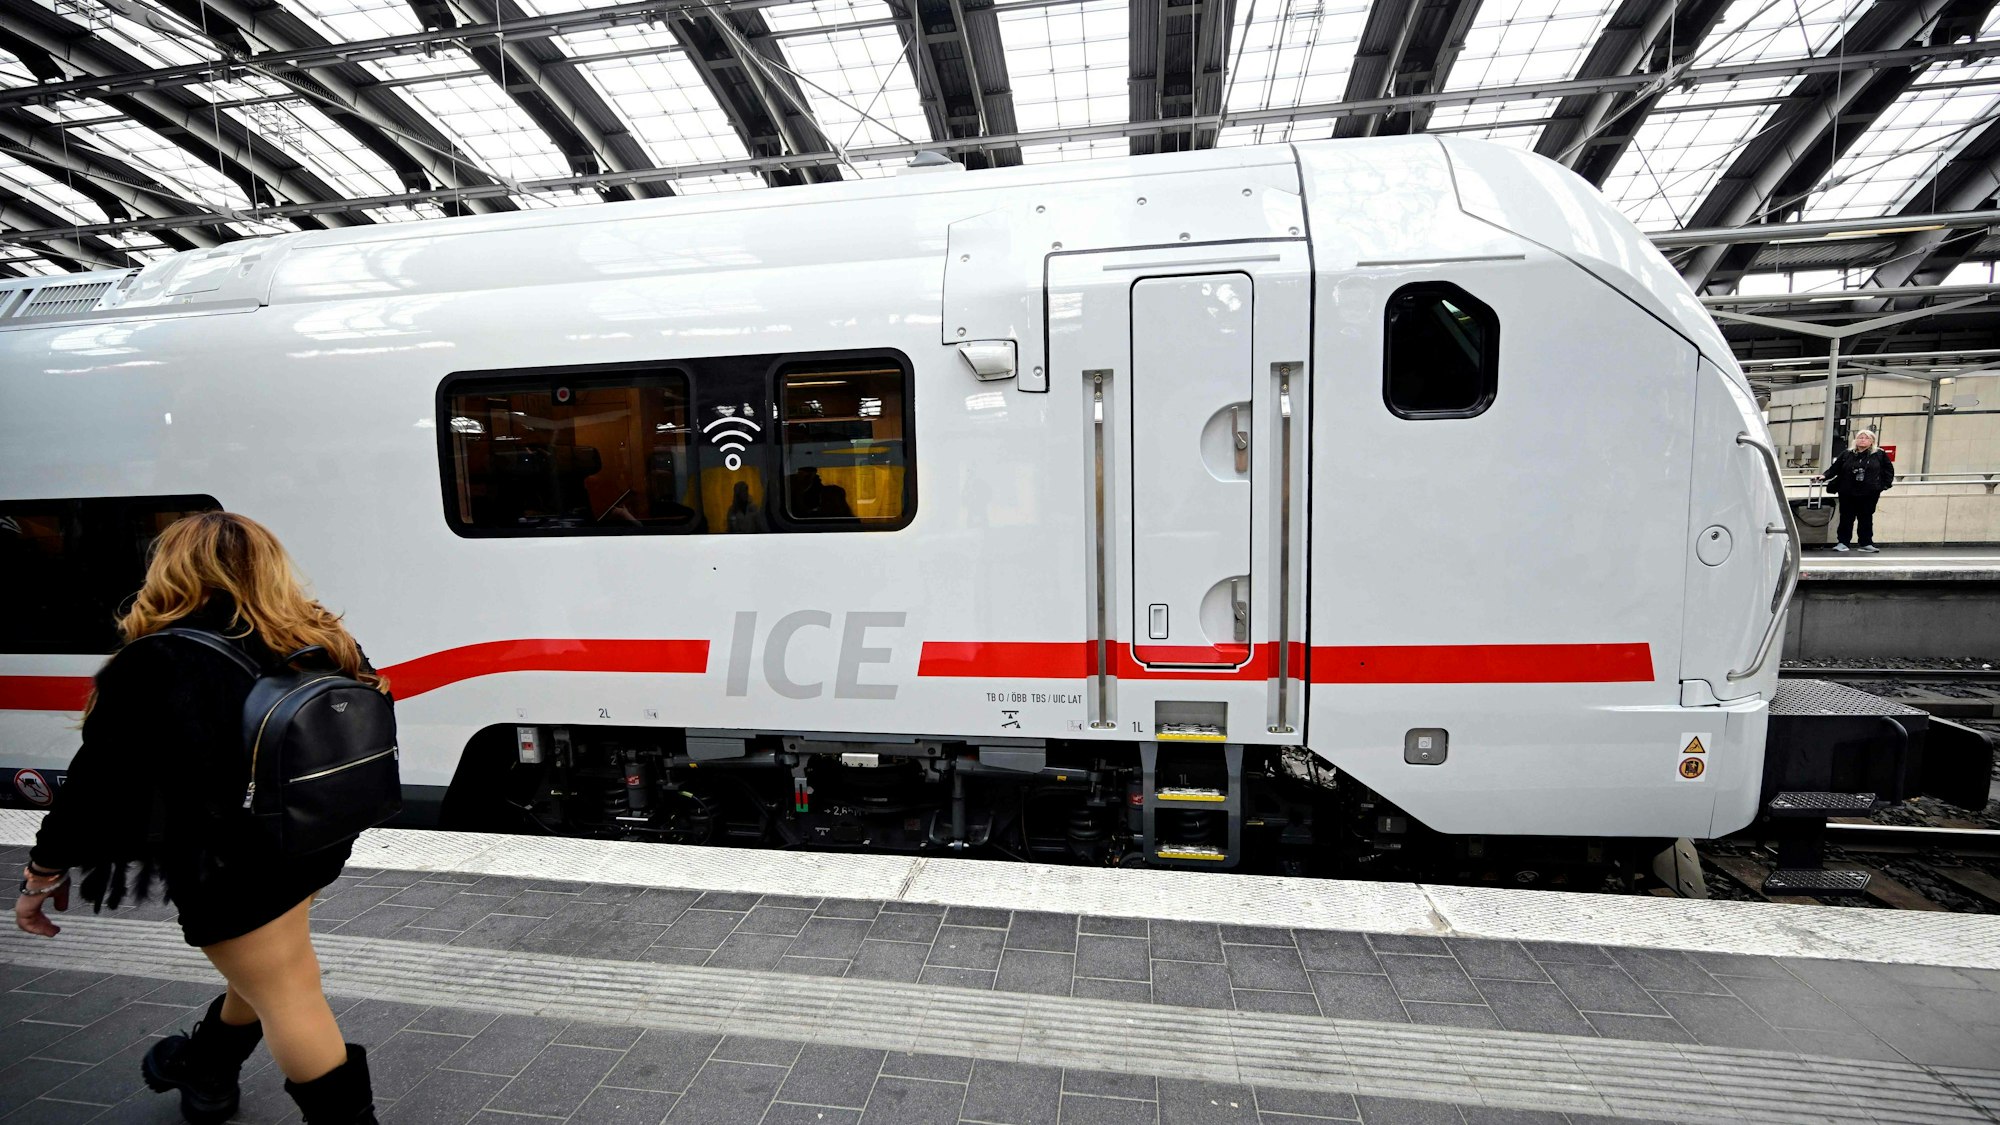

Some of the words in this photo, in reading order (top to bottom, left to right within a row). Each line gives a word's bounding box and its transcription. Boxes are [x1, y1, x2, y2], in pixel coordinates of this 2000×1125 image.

[725, 609, 907, 700] ICE
[986, 693, 996, 702] TB
[1011, 692, 1027, 702] ÖBB
[1031, 694, 1046, 703] TBS
[1053, 694, 1066, 703] UIC
[1068, 694, 1082, 704] LAT
[598, 708, 611, 719] 2L
[1131, 721, 1143, 733] 1L
[1178, 773, 1190, 785] 1L
